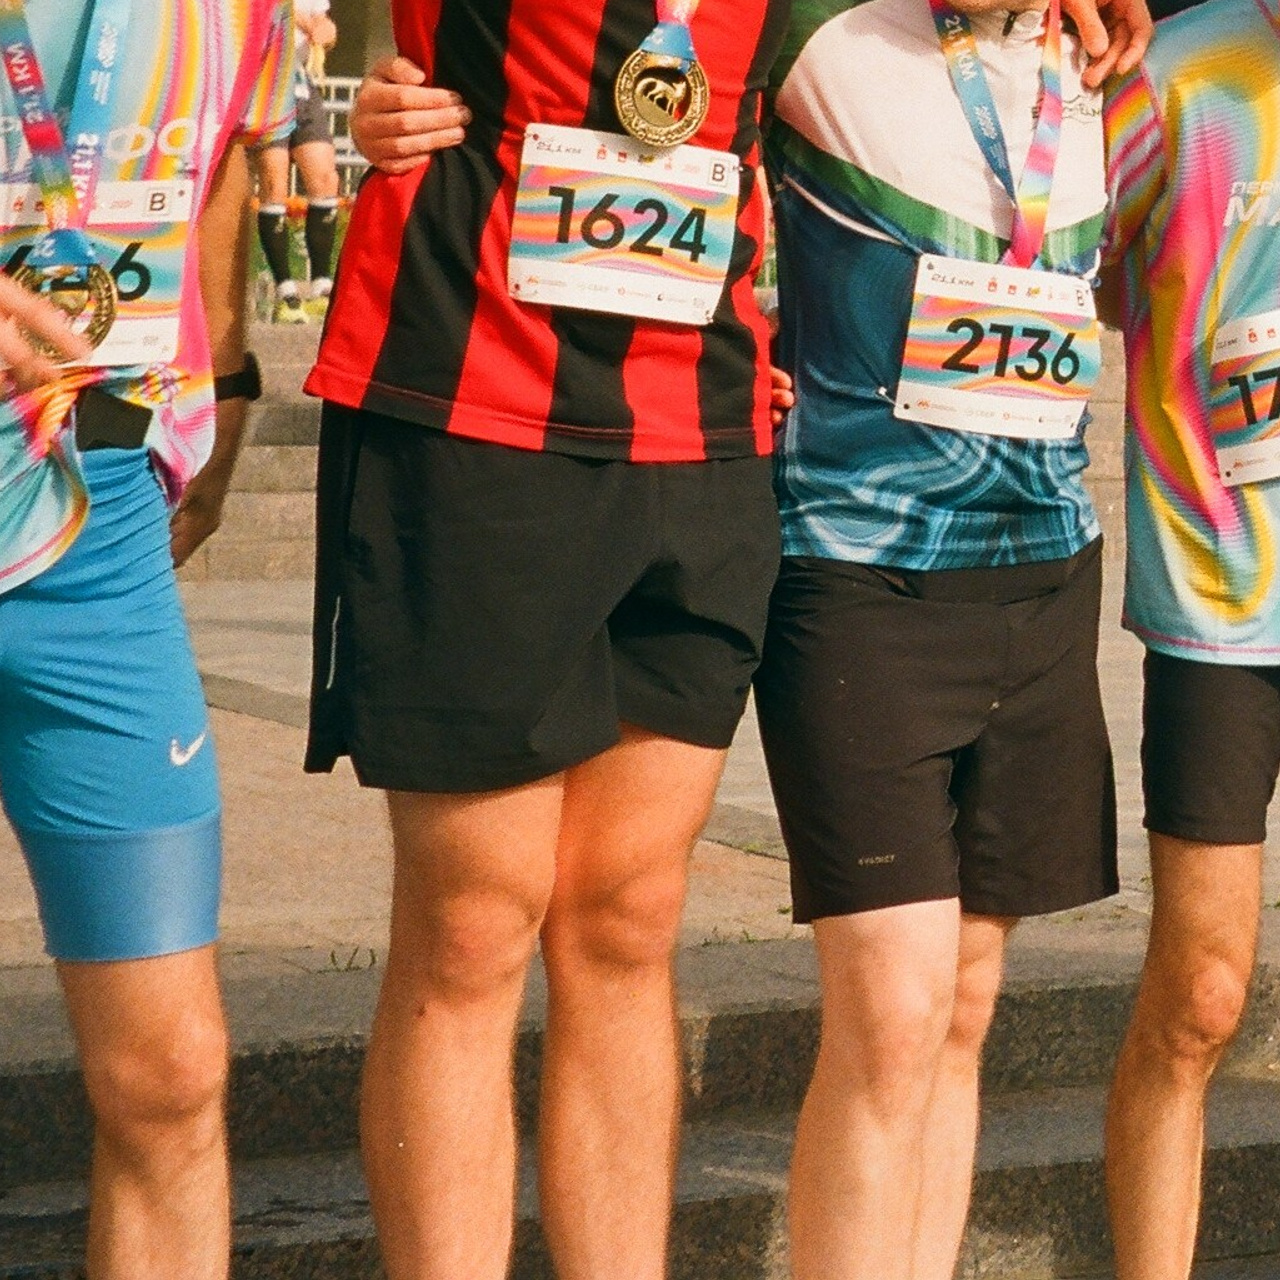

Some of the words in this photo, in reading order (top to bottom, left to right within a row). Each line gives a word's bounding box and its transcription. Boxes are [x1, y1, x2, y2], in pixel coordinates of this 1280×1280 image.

[943, 14, 968, 50] 21,1
[549, 185, 706, 263] 1624
[941, 317, 1080, 385] 2136
